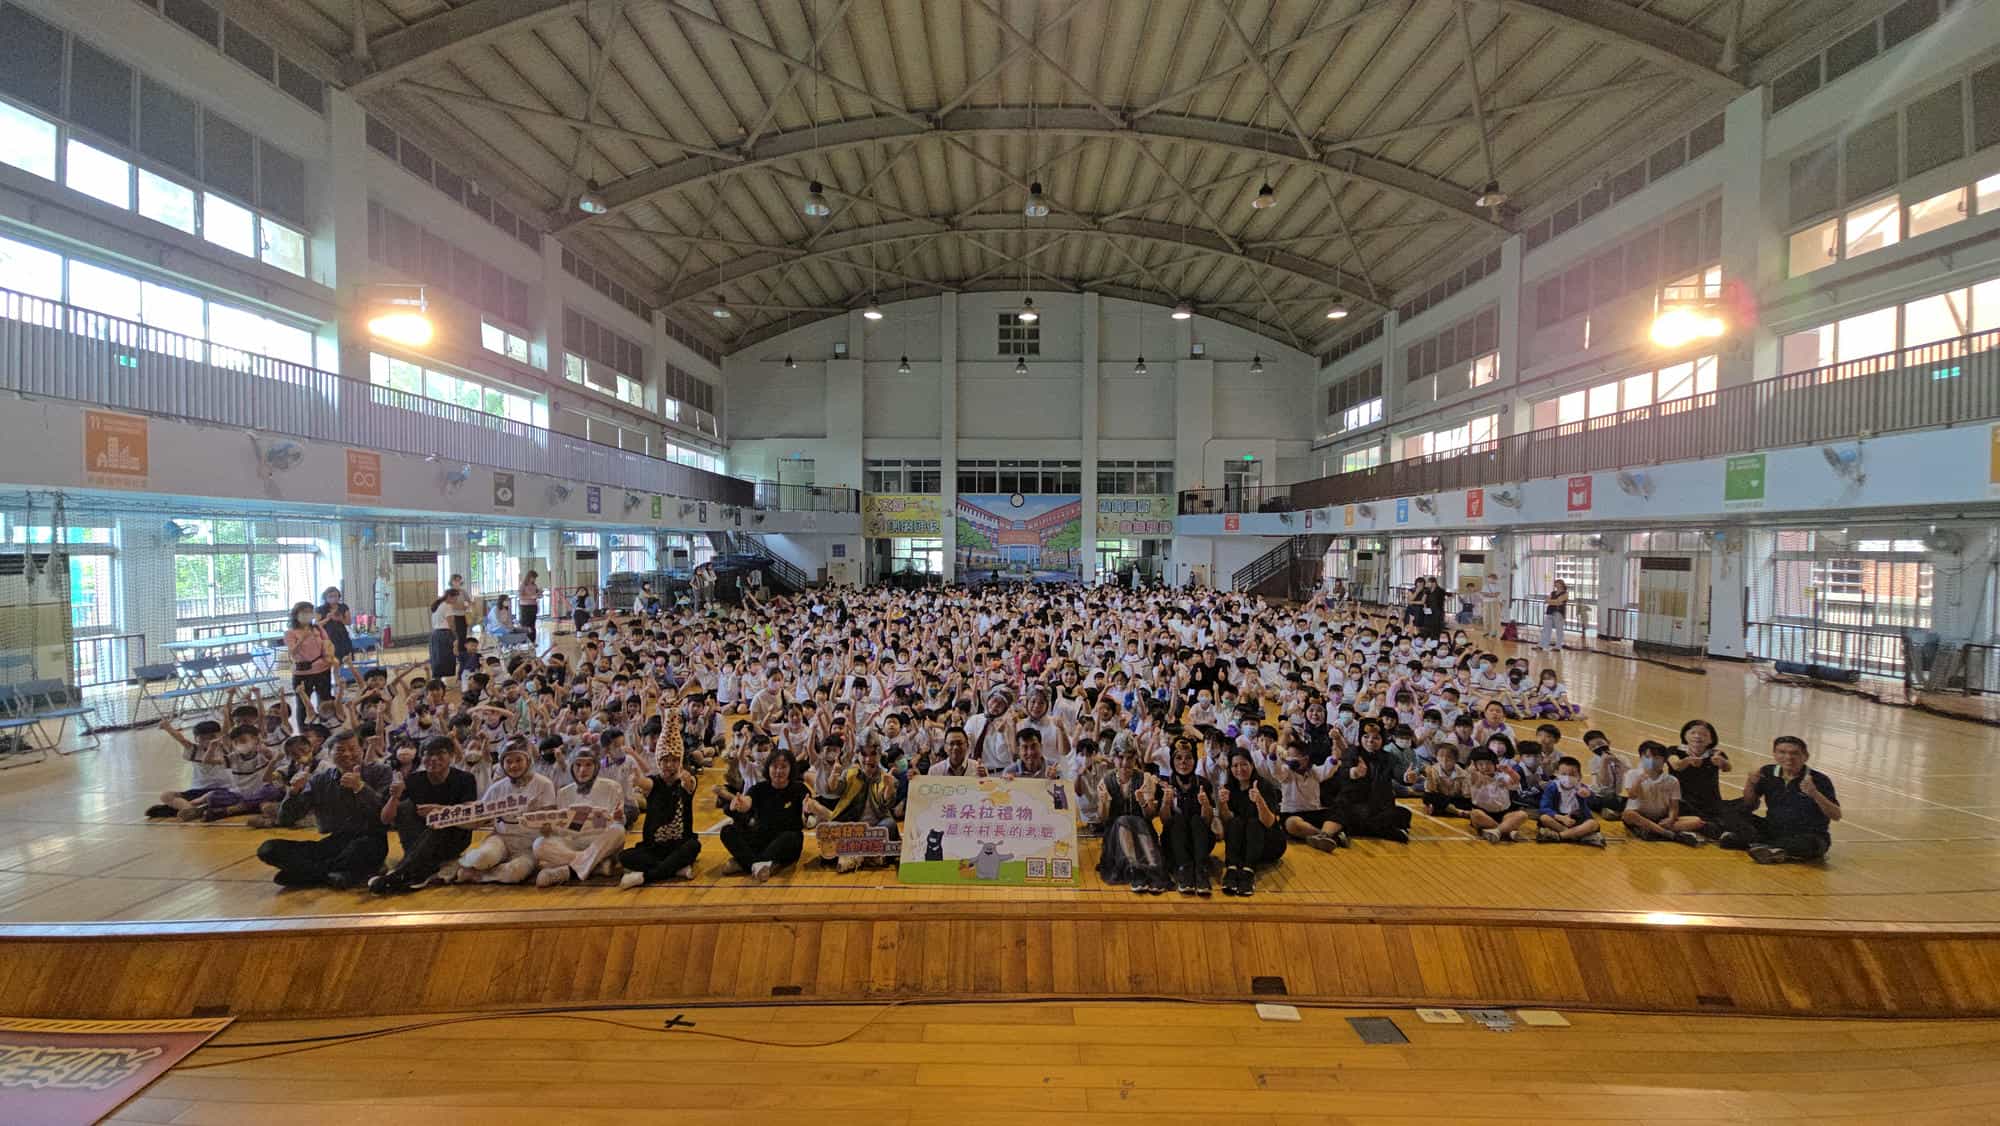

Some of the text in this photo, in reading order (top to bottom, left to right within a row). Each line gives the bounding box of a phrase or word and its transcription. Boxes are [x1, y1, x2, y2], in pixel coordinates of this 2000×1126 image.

[940, 804, 1033, 821] 潘朵拉禮物
